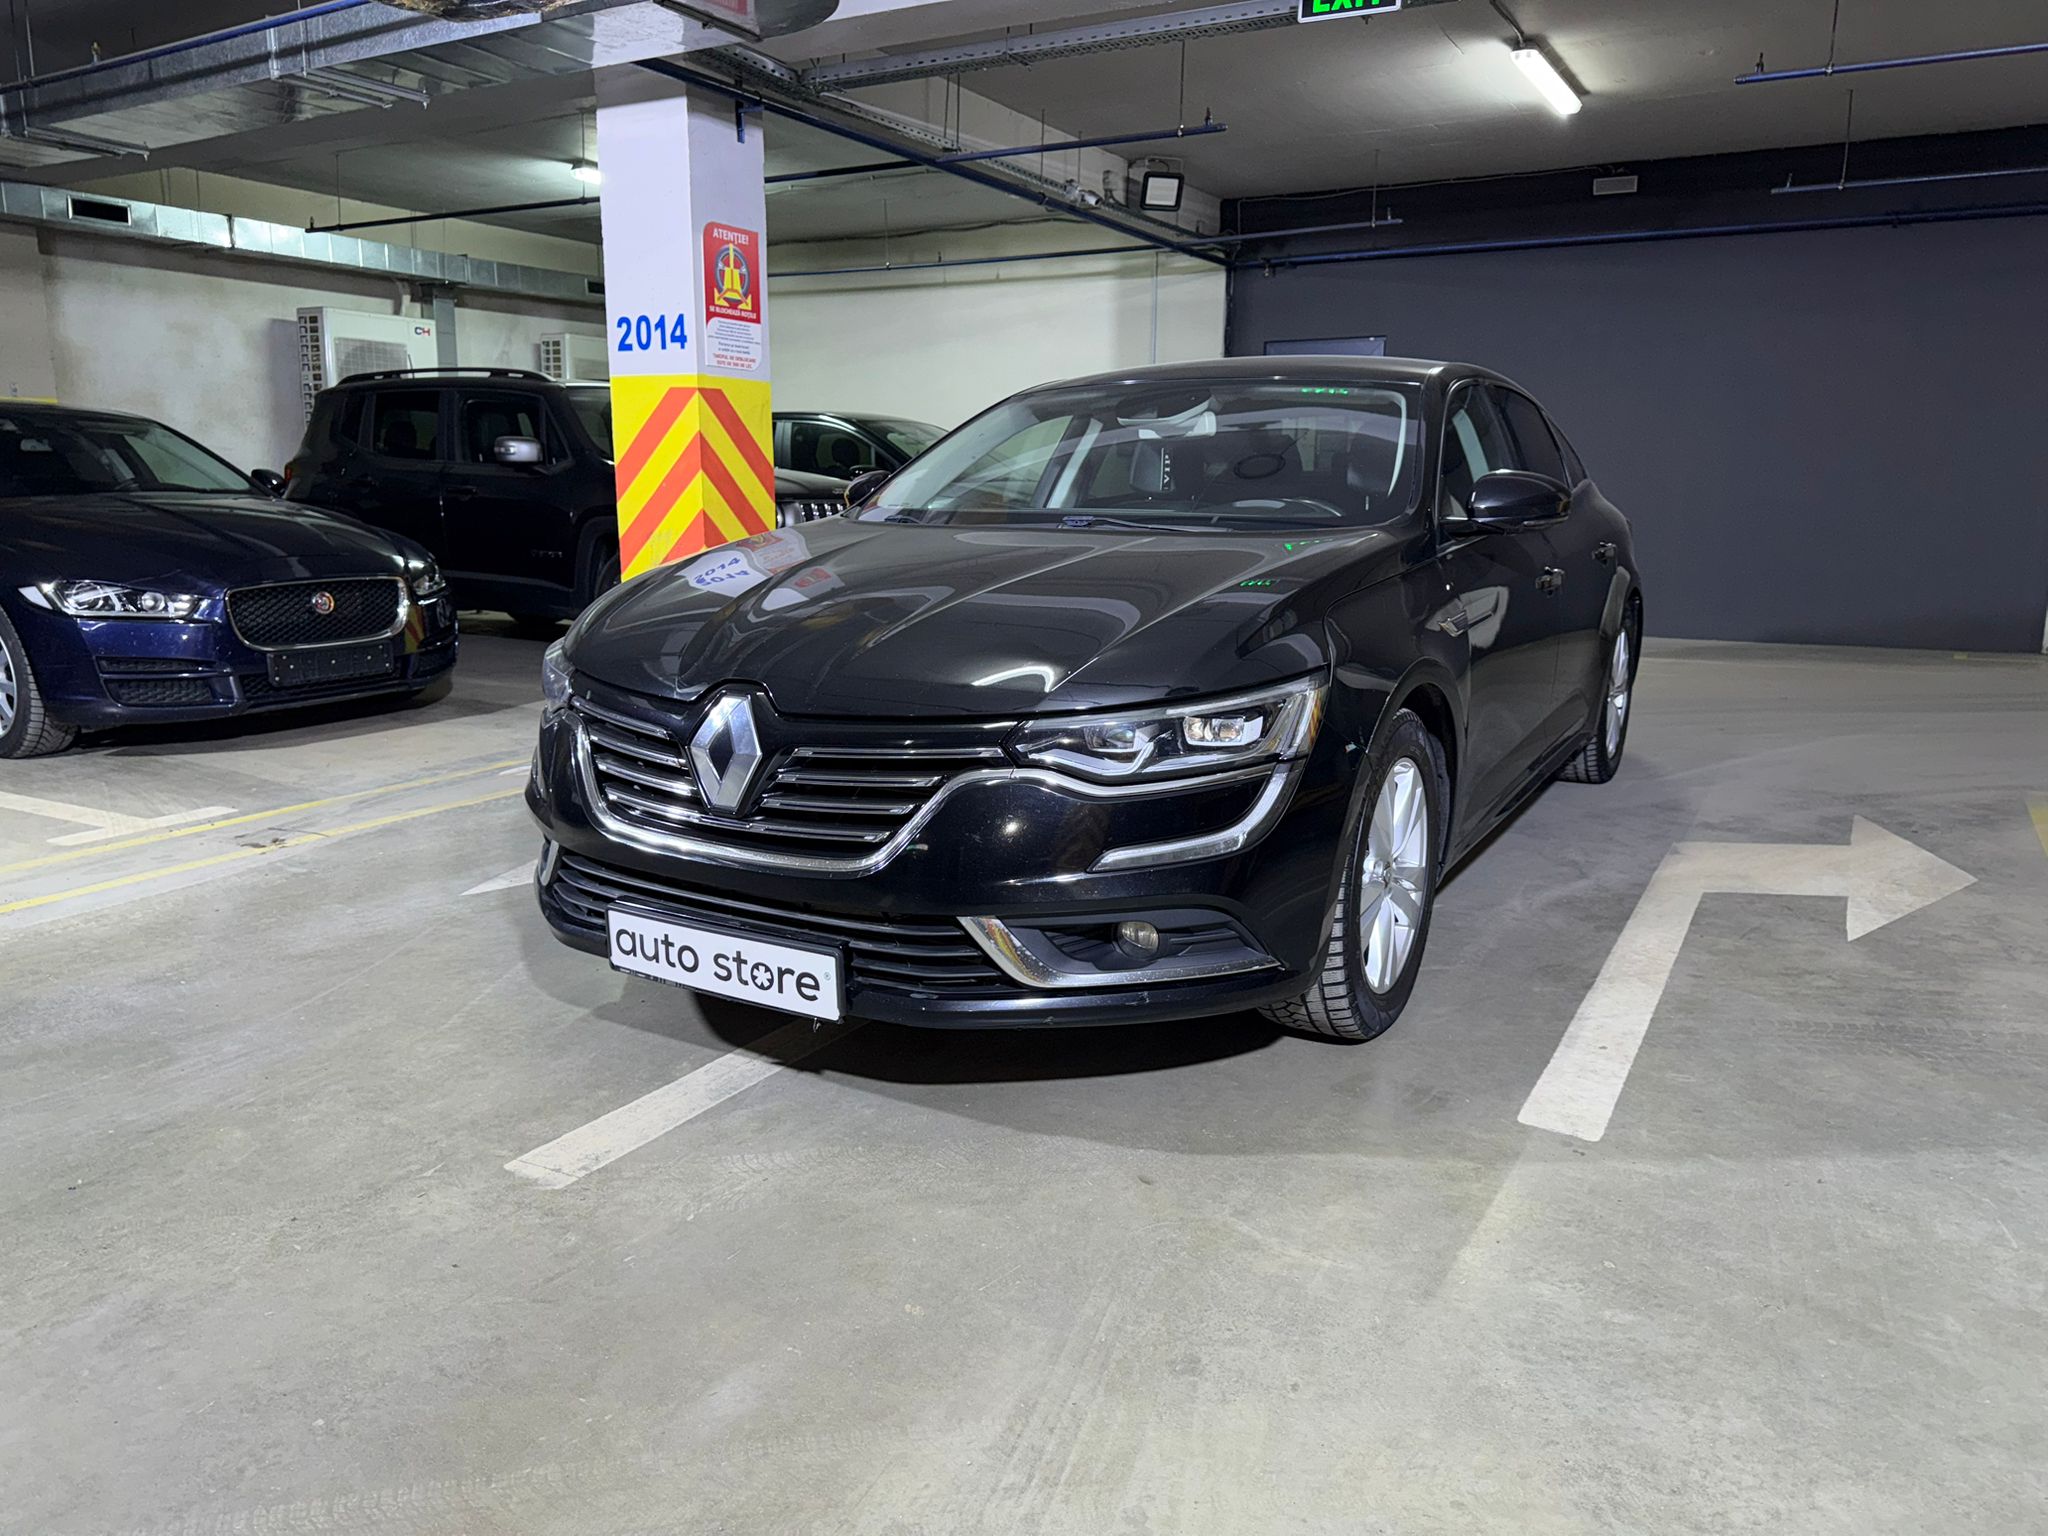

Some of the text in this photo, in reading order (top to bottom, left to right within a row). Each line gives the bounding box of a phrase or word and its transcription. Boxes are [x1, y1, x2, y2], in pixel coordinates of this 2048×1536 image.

[1313, 0, 1380, 13] EX
[617, 313, 687, 352] 2014
[616, 928, 820, 1001] auto store
